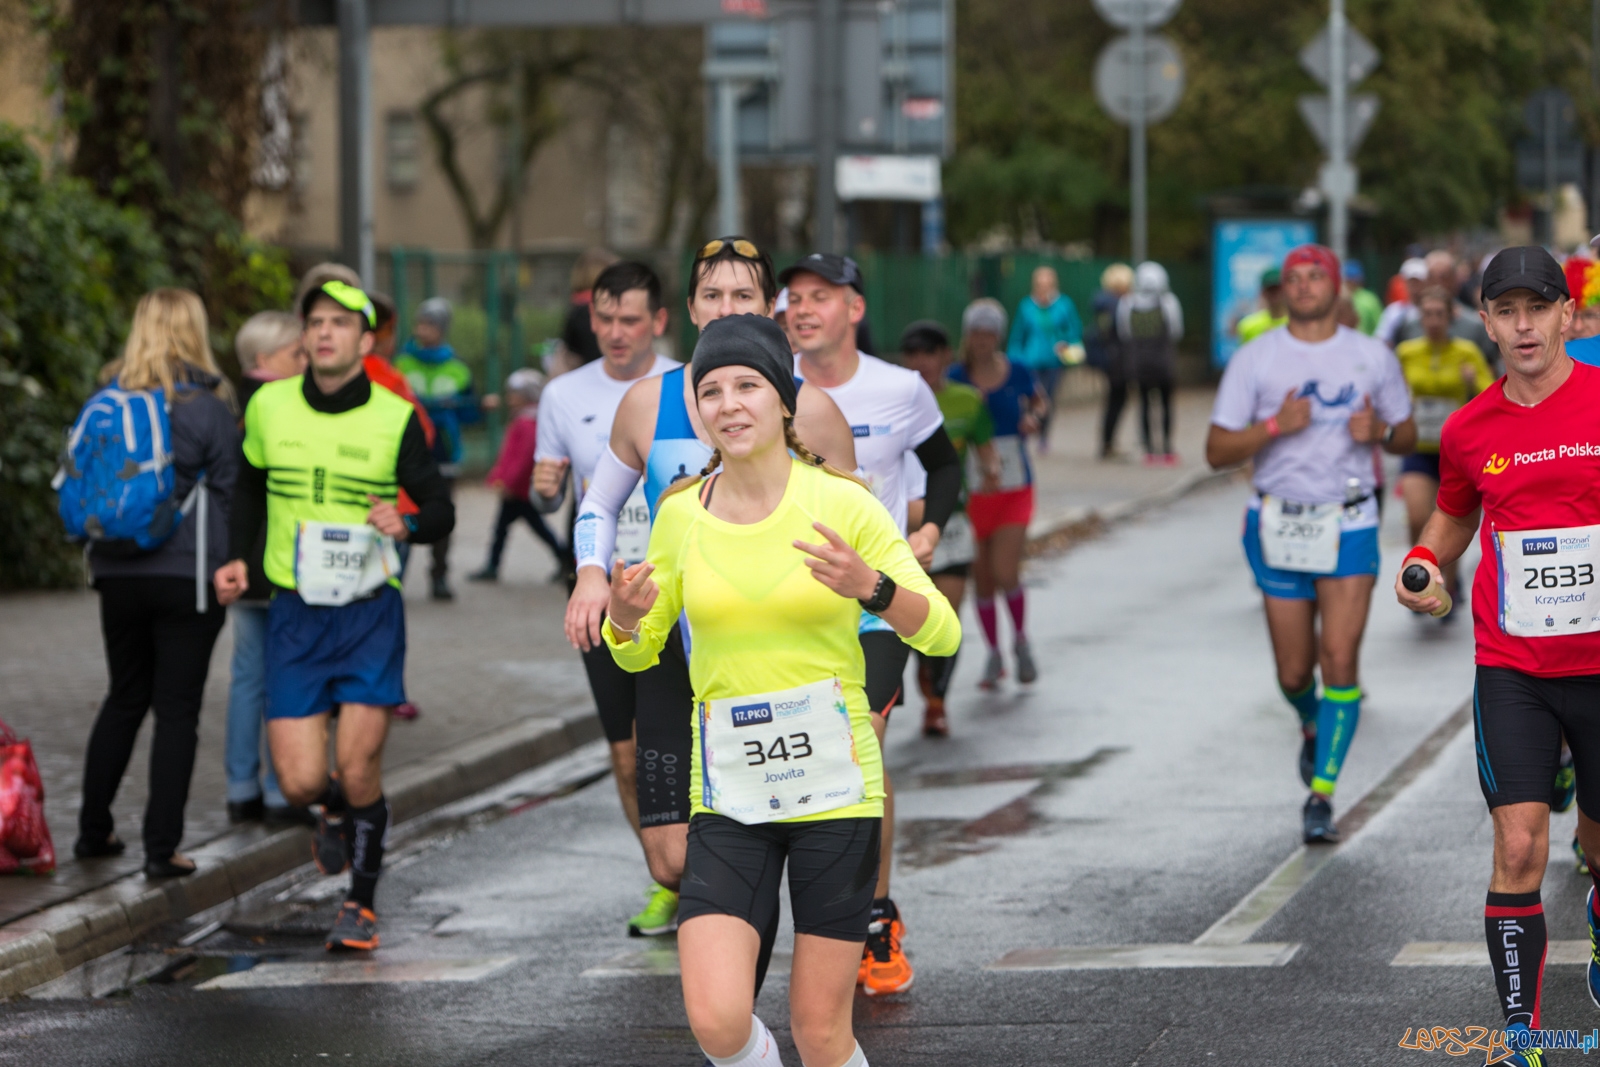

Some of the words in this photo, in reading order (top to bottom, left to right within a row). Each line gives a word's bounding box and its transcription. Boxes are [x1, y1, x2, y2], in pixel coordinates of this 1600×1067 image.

[1514, 448, 1556, 466] Poczta
[1559, 442, 1600, 459] Polska
[1524, 563, 1595, 589] 2633
[1535, 592, 1586, 606] Krzysztof
[744, 732, 813, 766] 343
[764, 768, 805, 783] Jowita
